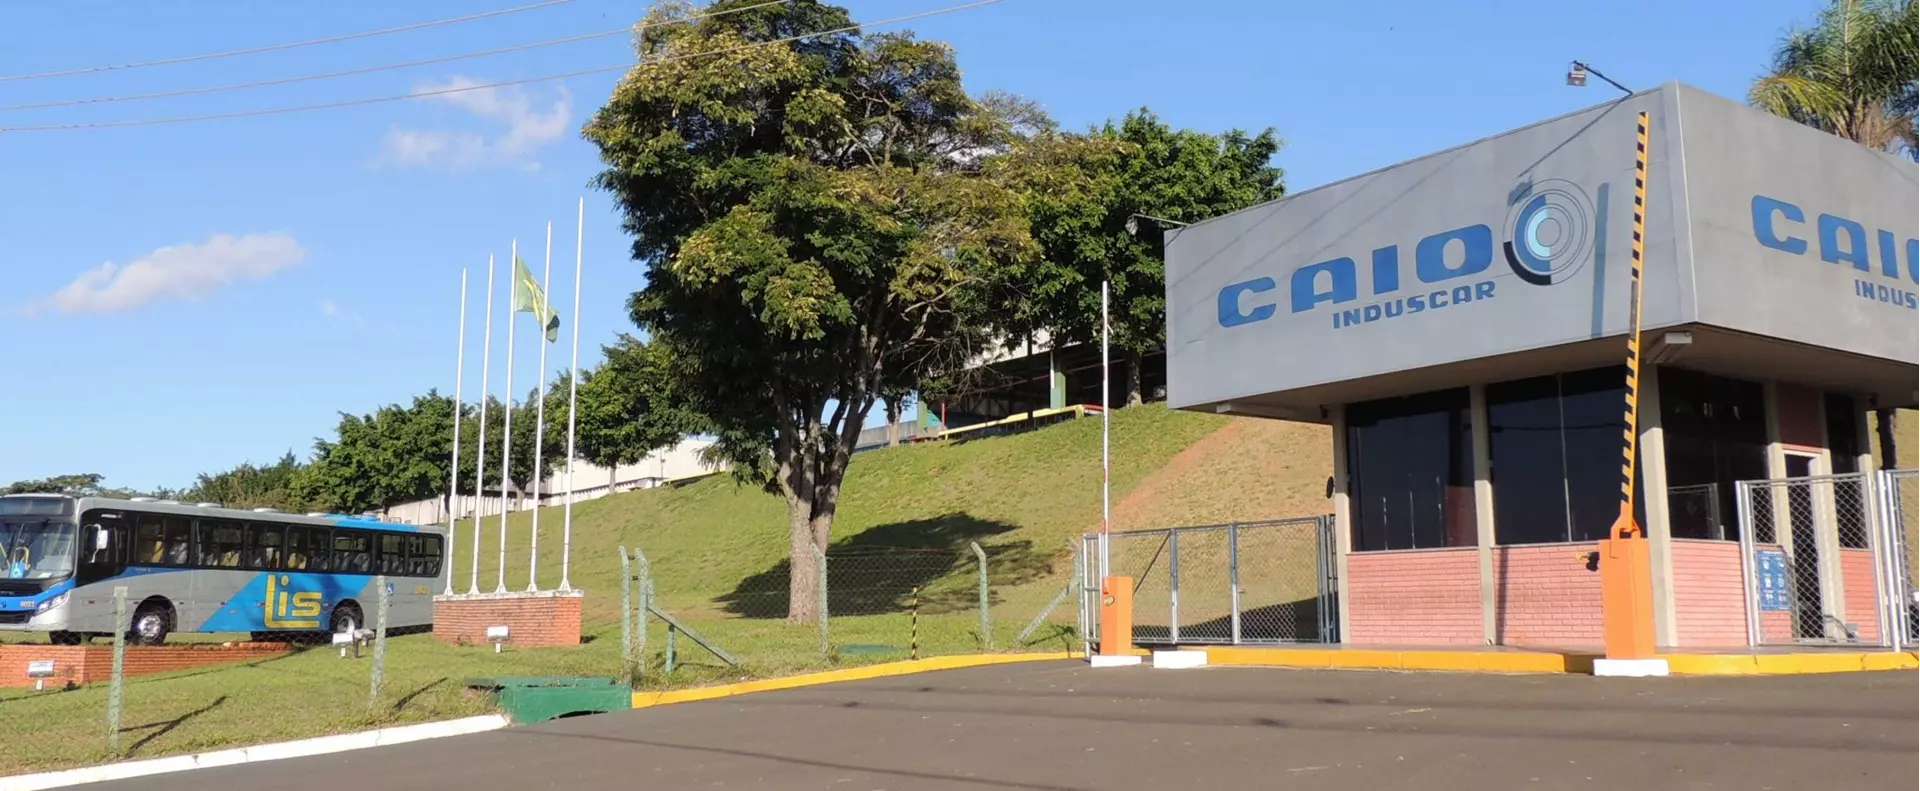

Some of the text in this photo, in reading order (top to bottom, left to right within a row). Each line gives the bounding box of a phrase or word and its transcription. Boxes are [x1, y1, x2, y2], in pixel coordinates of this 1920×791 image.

[1217, 223, 1493, 328] CAIO
[1854, 279, 1920, 310] INDUS
[1332, 280, 1496, 329] INDUSCAR
